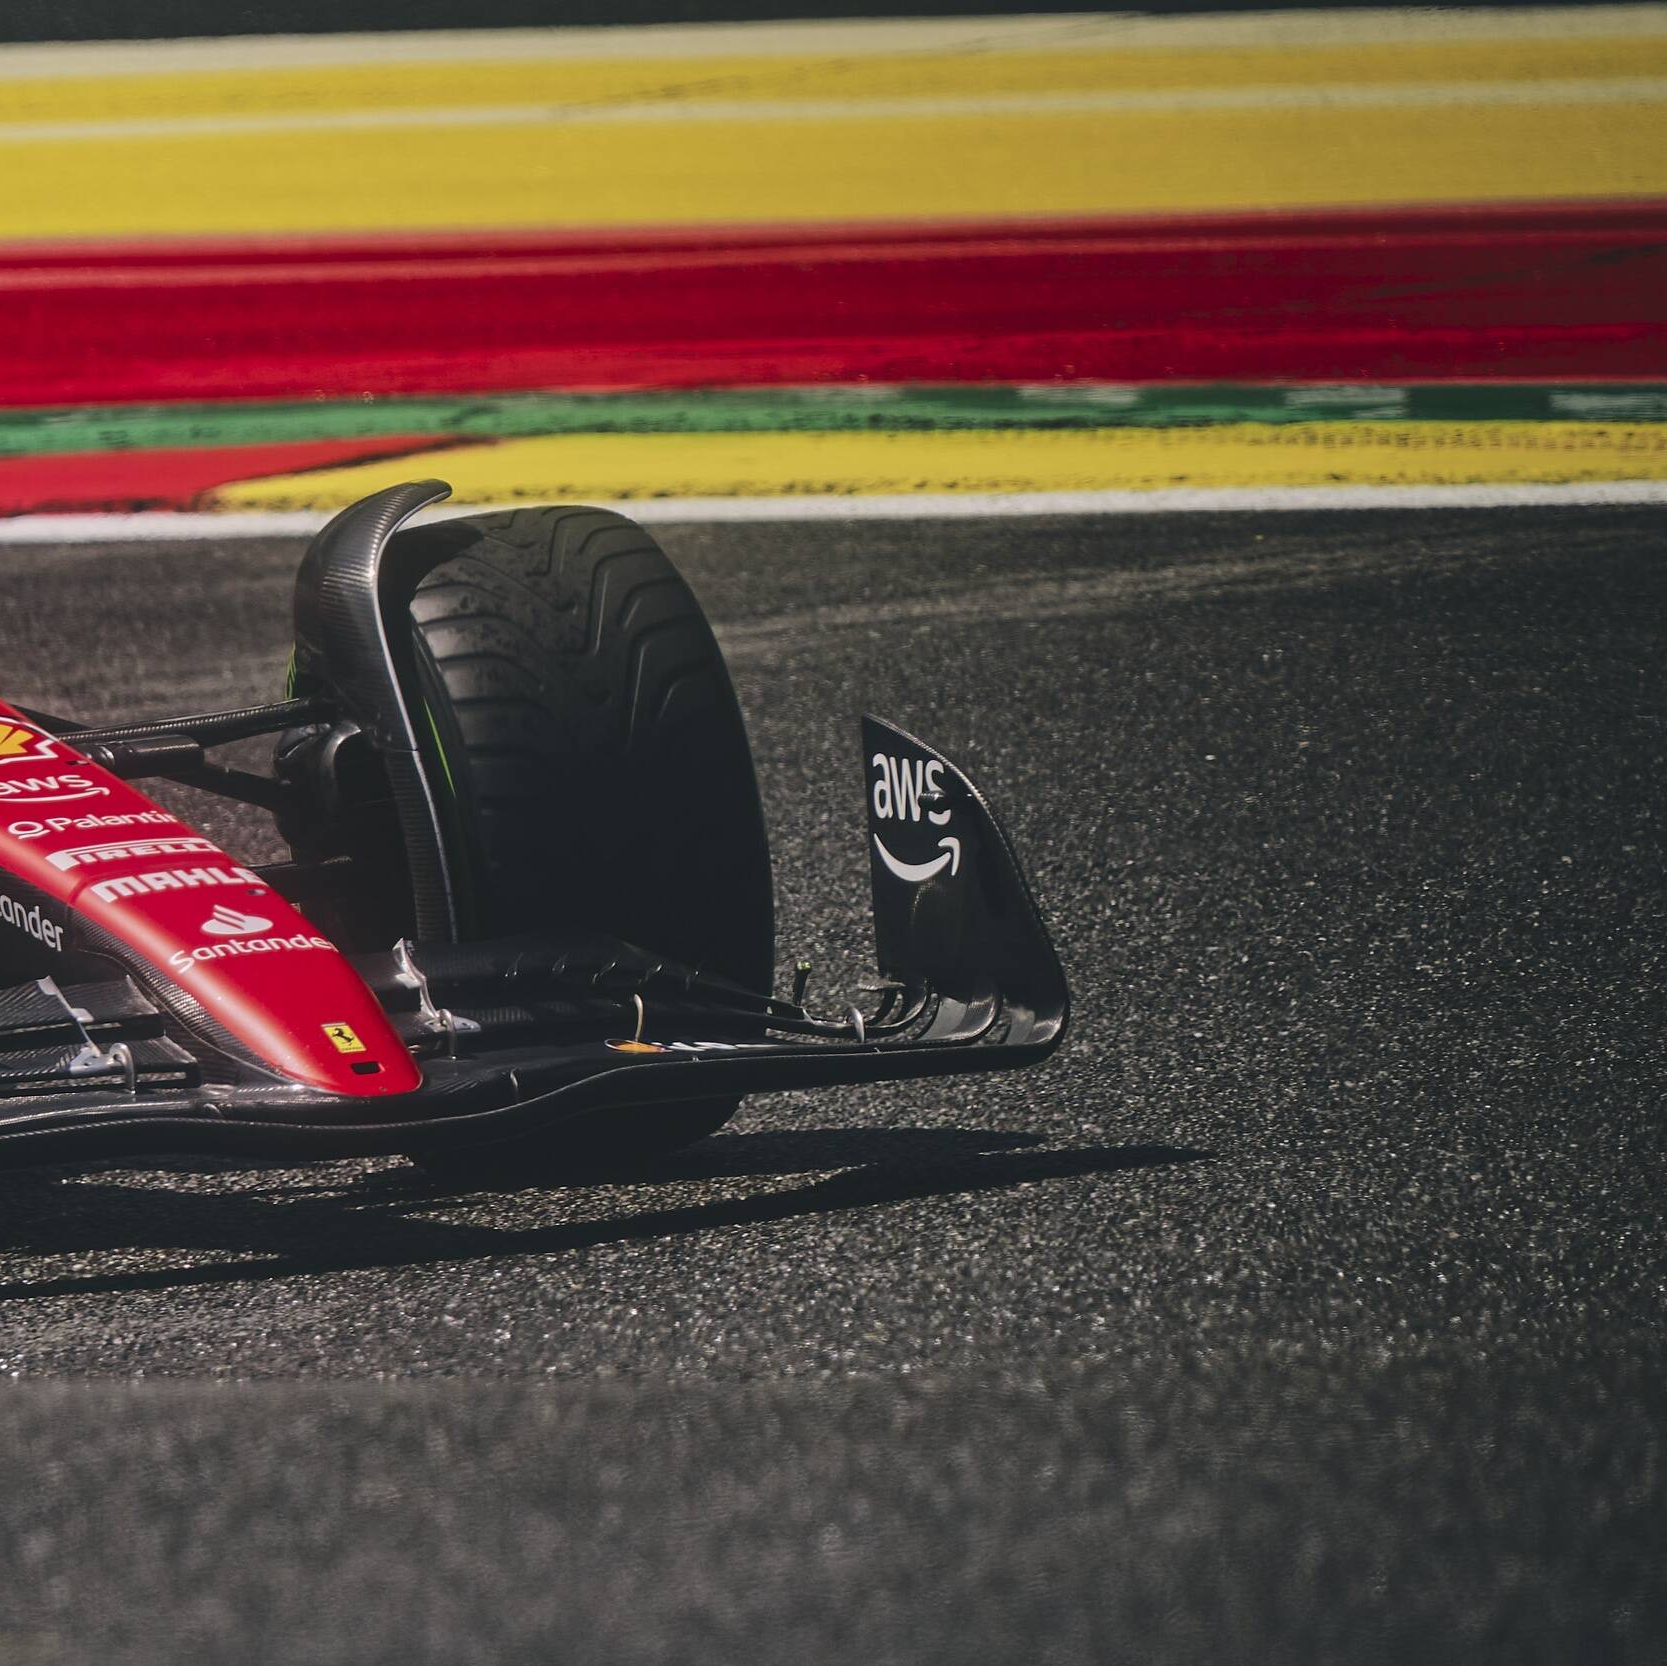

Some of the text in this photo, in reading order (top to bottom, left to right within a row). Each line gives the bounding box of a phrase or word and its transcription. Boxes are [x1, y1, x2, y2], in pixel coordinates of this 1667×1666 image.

[872, 752, 952, 826] aws
[45, 810, 179, 832] Palantir
[44, 837, 224, 872] PIRELLI
[90, 866, 269, 904] MAHLE
